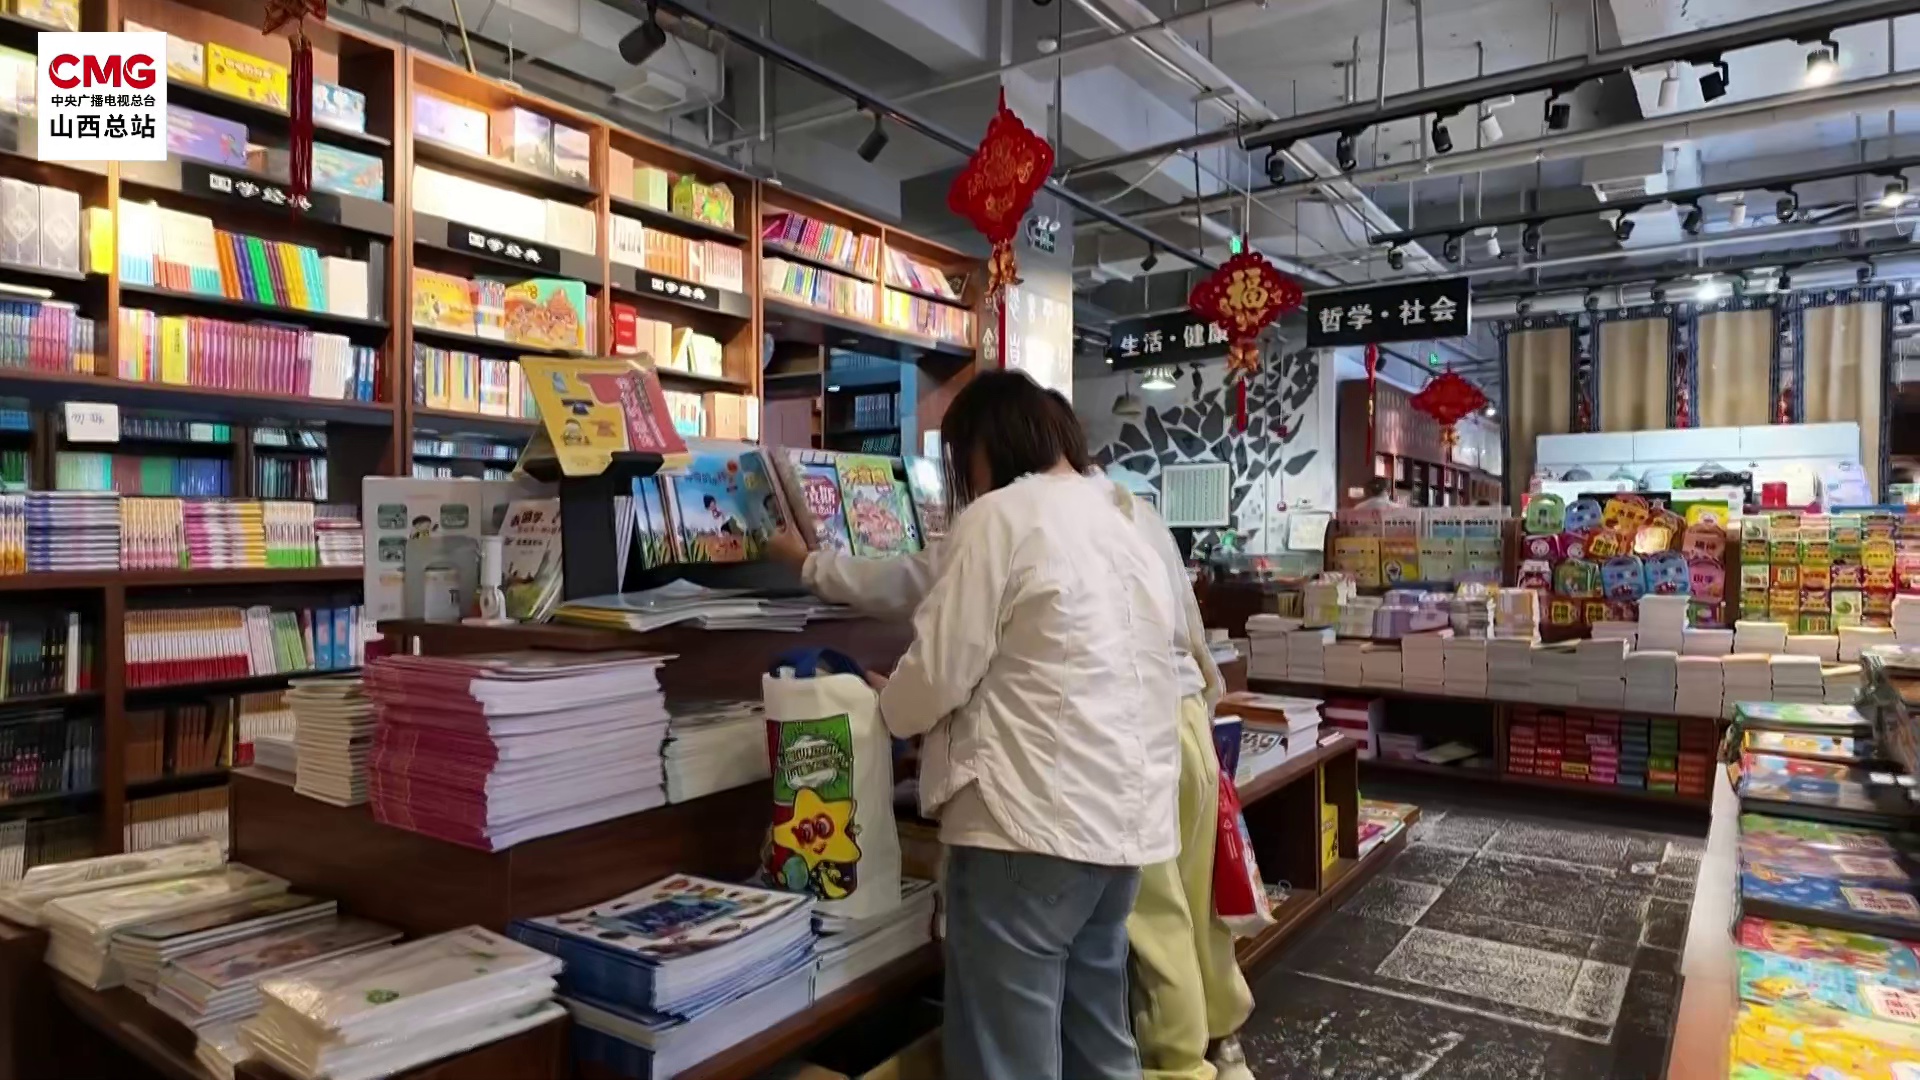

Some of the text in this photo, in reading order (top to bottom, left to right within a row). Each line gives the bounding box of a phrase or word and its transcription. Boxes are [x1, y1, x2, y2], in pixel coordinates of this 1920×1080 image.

[1226, 267, 1268, 310] 福
[1319, 295, 1457, 333] 哲学·社会
